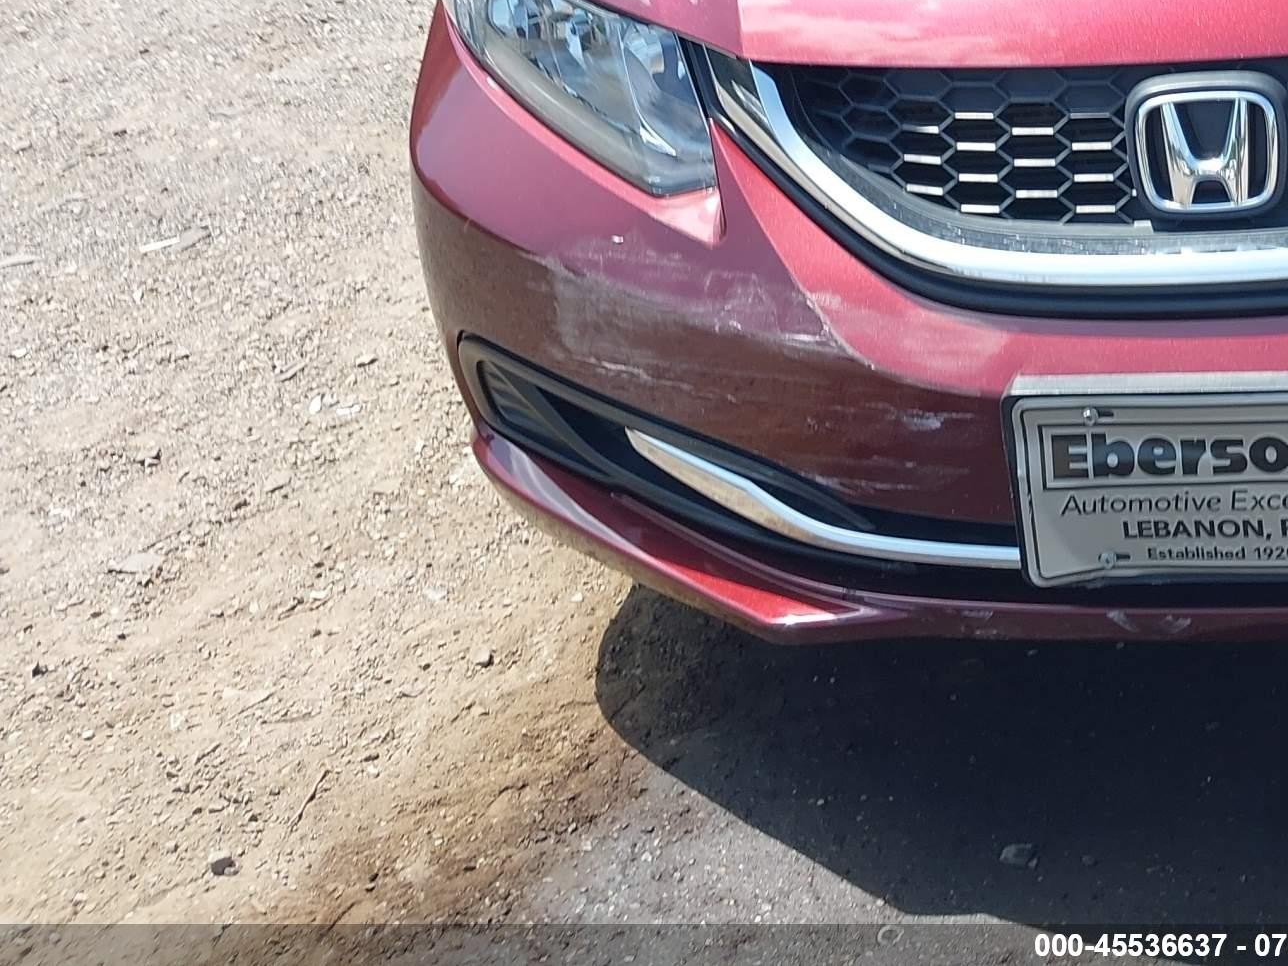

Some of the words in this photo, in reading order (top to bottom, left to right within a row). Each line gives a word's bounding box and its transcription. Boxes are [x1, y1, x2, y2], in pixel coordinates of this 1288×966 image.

[1061, 491, 1221, 516] Automotive
[1122, 519, 1272, 540] LEBANON,
[1147, 546, 1246, 561] Established
